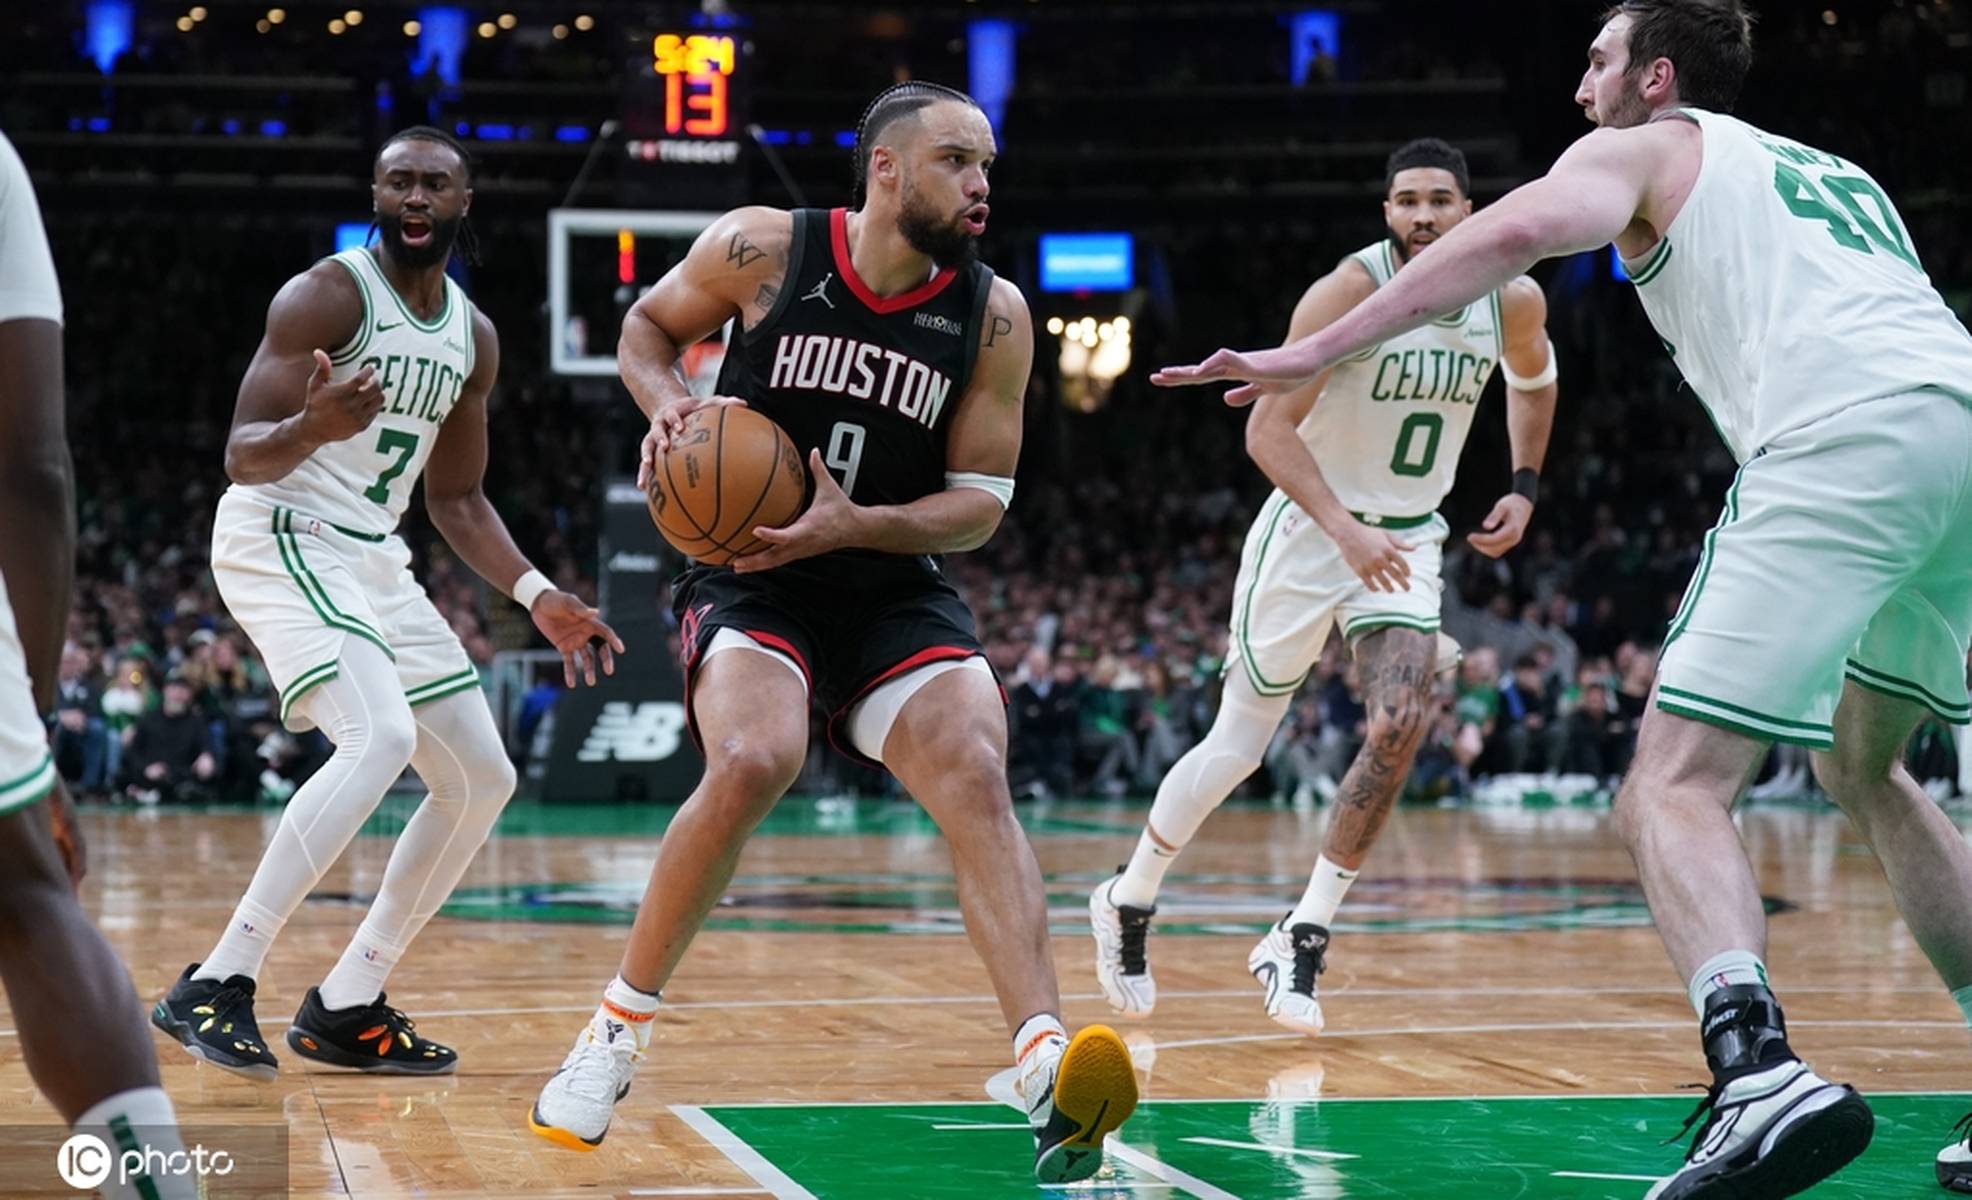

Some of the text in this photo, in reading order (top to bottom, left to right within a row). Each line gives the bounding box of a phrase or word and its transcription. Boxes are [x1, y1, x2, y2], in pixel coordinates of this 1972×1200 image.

[654, 34, 735, 75] 5:24
[665, 67, 727, 136] 13
[1773, 160, 1923, 274] 40
[769, 334, 952, 430] HOUSTON
[1371, 349, 1491, 405] CELTICS
[363, 427, 420, 505] 7
[826, 420, 867, 497] 9
[1390, 412, 1444, 478] 0
[576, 702, 686, 762] NB
